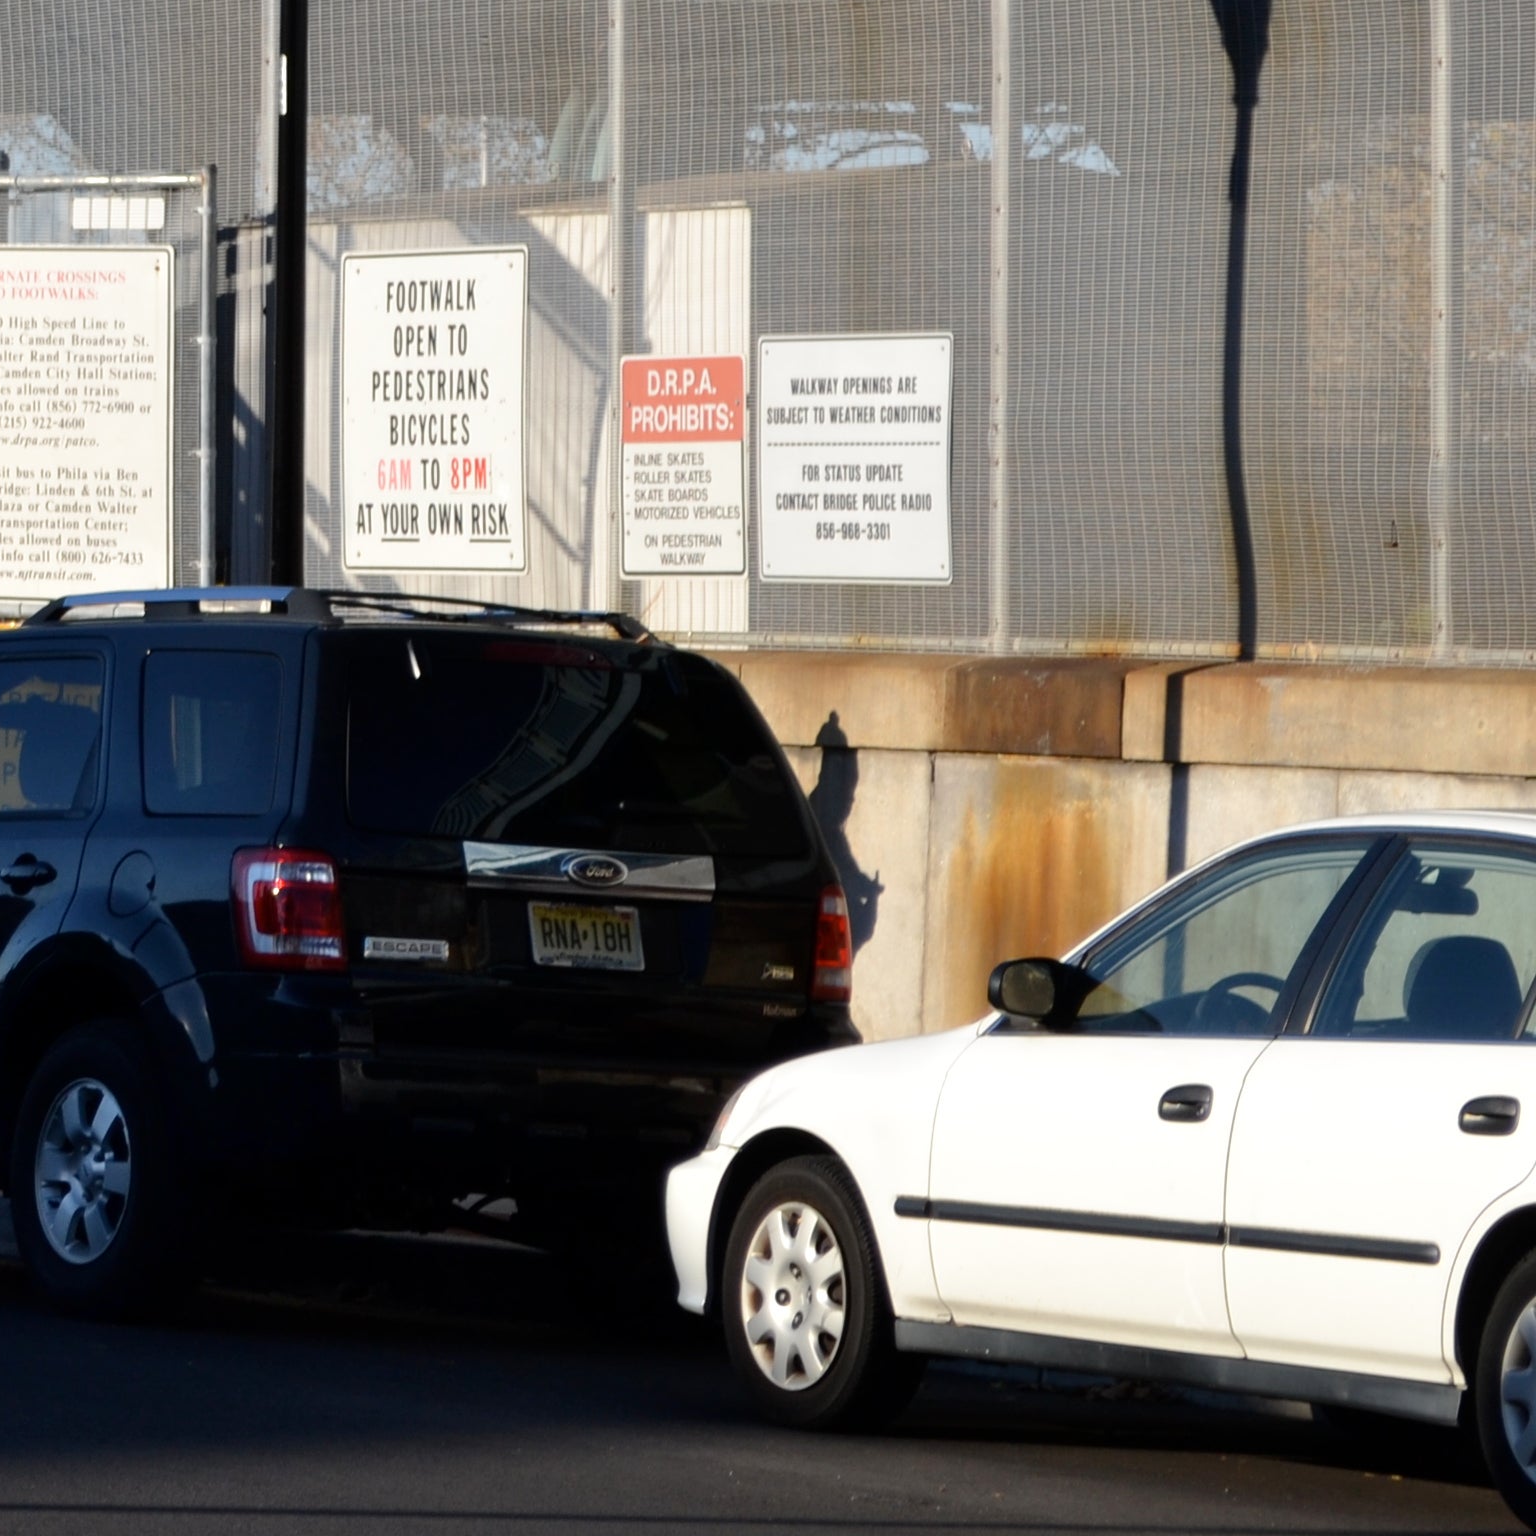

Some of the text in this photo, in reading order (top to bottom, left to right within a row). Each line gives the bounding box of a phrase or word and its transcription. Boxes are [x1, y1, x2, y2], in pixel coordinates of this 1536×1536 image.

[46, 270, 126, 284] CROSSINGS
[11, 287, 100, 301] FOOTWALKS:
[386, 278, 477, 314] FOOTWALK
[9, 316, 38, 332] High
[43, 317, 76, 332] Speed
[82, 317, 108, 330] Line
[114, 318, 125, 330] to
[19, 334, 65, 346] Camden
[71, 334, 128, 348] Broadway
[132, 335, 150, 347] St.
[393, 324, 468, 358] OPEN TO
[29, 350, 59, 363] Rand
[66, 351, 155, 366] Transportation
[46, 367, 71, 382] City
[77, 368, 103, 380] Hall
[647, 367, 717, 397] D.R.P.A.
[16, 384, 60, 396] allowed
[64, 387, 78, 397] on
[83, 385, 120, 397] trains
[372, 368, 490, 402] PEDESTRIANS
[790, 376, 918, 395] WALKWAY OPENINGS ARE
[19, 401, 41, 413] call
[46, 400, 77, 415] (856)
[82, 401, 135, 414] 772-6900
[139, 404, 152, 414] or
[766, 405, 942, 425] SUBJECT TO WEATHER CONDITIONS
[32, 417, 86, 430] 922-4600
[631, 402, 735, 433] PROHIBITS:
[389, 413, 471, 447] BICYCLES
[633, 452, 705, 467] INLINE SKATES
[16, 465, 35, 479] bus
[40, 467, 52, 479] to
[57, 466, 88, 480] Phila
[93, 468, 111, 481] via
[116, 467, 139, 481] Ben
[377, 457, 488, 491] 6AM TO 8PM
[633, 470, 712, 485] ROLLER SKATES
[802, 464, 903, 482] FOR STATUS UPDATE
[36, 484, 76, 497] Linden
[81, 484, 91, 497] &
[95, 484, 115, 497] 6th
[119, 485, 137, 498] St.
[141, 486, 153, 498] at
[633, 488, 709, 503] SKATE BOARDS
[28, 502, 40, 512] or
[45, 500, 92, 513] Camden
[97, 501, 138, 514] Walter
[776, 493, 932, 512] CONTACT BRIDGE POLICE RADIO
[356, 503, 510, 537] AT YOUR OWN RISK
[634, 505, 741, 521] MOTORIZED VEHICLES
[816, 521, 891, 541] 856-968-3301
[19, 534, 63, 547] allowed
[67, 537, 81, 547] on
[86, 534, 118, 547] buses
[644, 534, 723, 548] ON PEDESTRIAN
[1, 549, 24, 562] info
[28, 550, 51, 563] call
[55, 551, 86, 565] (800)
[91, 551, 144, 565] 626-7433
[660, 552, 706, 566] WALKWAY
[586, 862, 614, 878] Ford
[372, 940, 443, 955] ESCAPE
